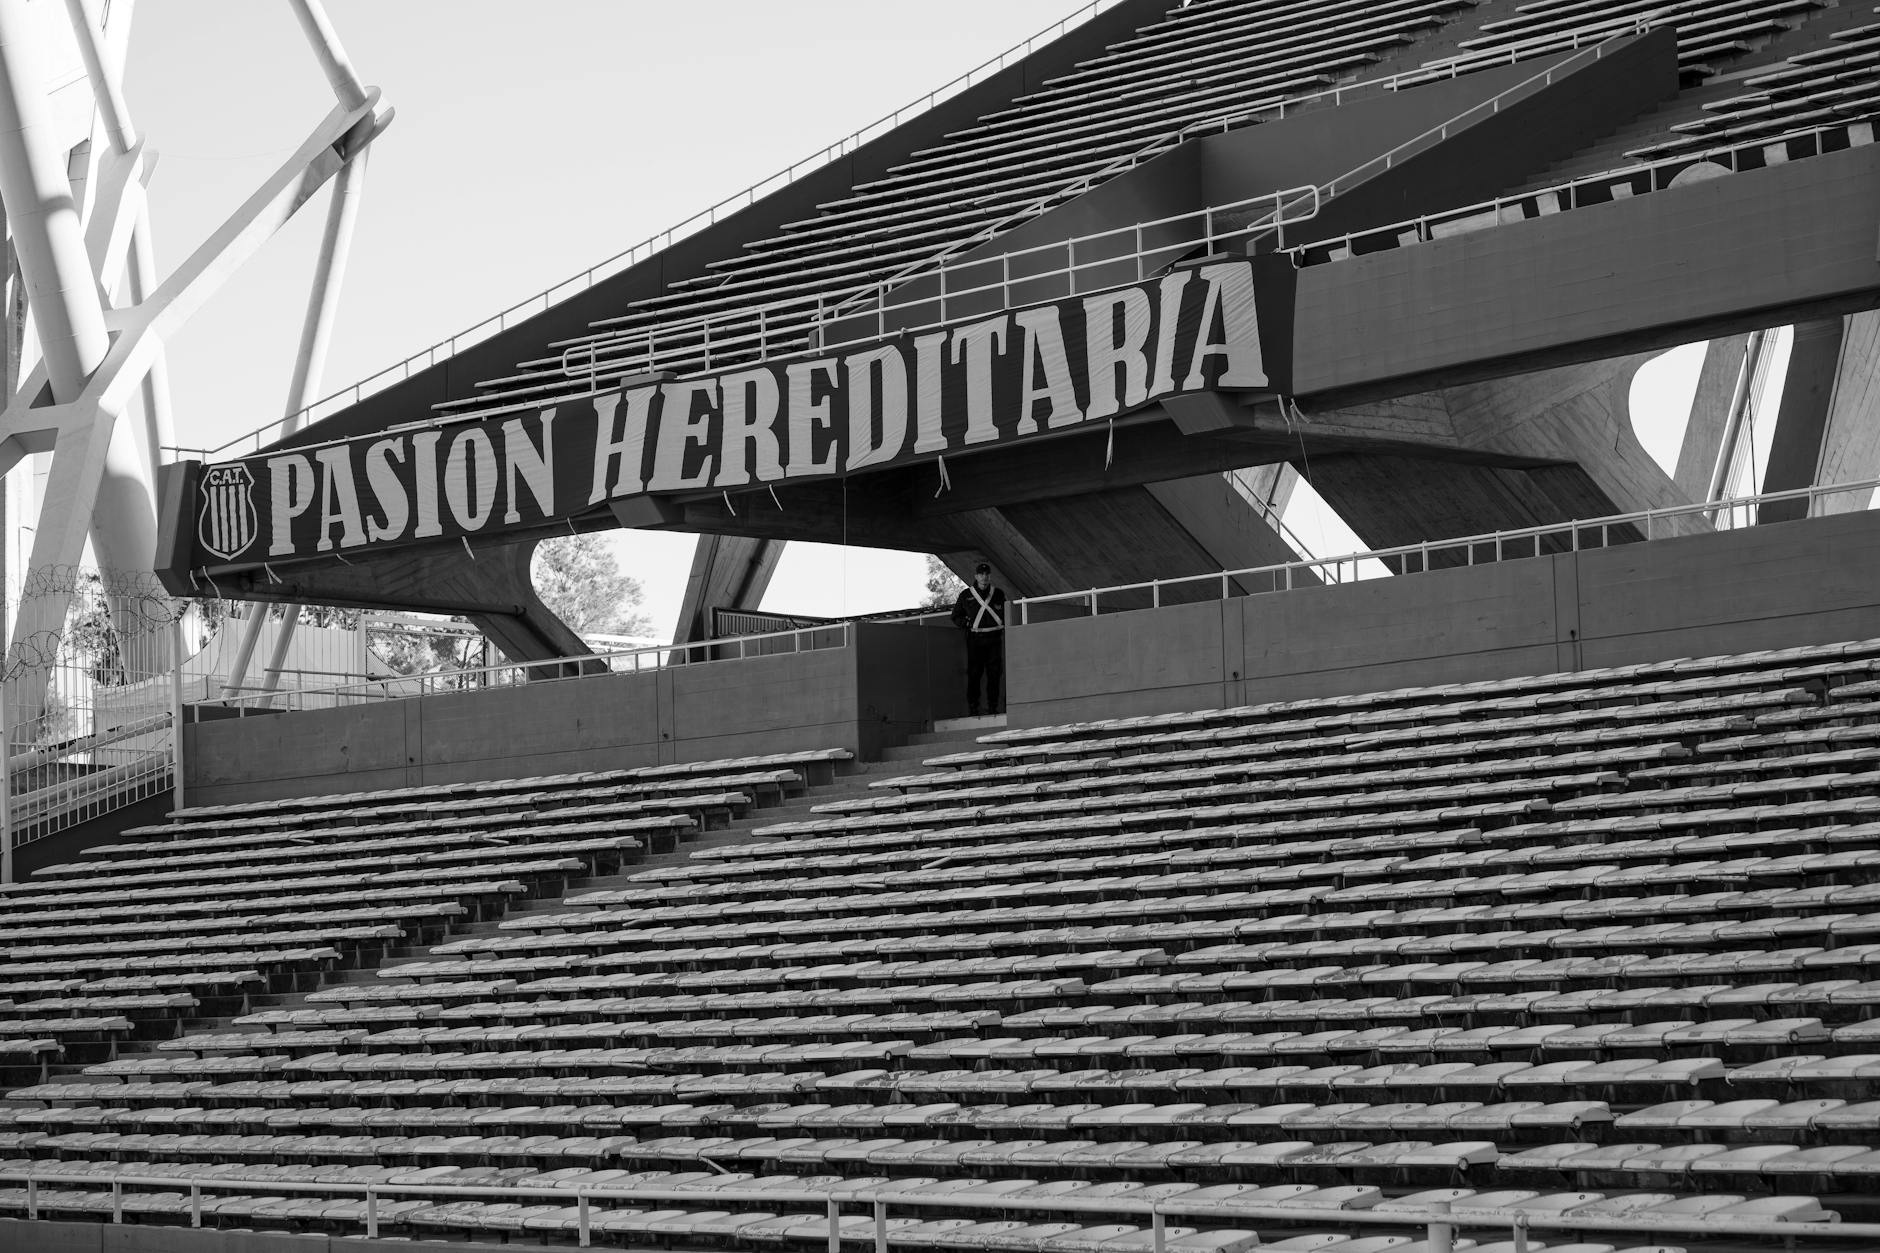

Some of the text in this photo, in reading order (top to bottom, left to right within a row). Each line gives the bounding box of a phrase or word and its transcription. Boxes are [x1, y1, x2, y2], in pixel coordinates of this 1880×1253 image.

[210, 468, 243, 485] C.A.T.
[266, 261, 1269, 556] PASION HEREDITARIA
